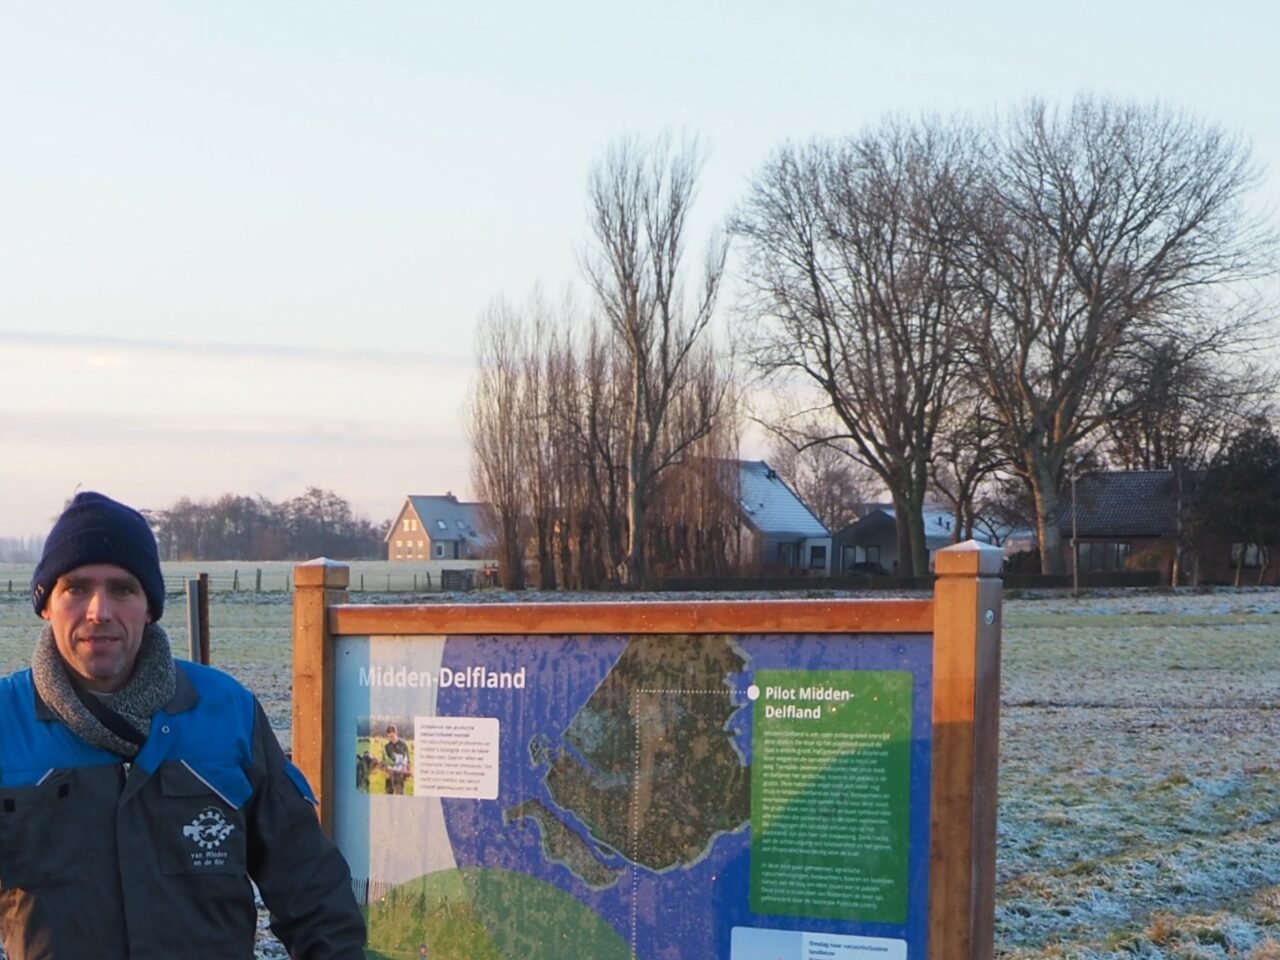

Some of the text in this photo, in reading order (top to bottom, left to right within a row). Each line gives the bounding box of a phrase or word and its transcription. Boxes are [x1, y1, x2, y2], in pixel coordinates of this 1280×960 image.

[359, 666, 526, 689] Midden-Delfland
[765, 686, 855, 701] Pilot Midden-
[765, 705, 821, 719] Delfland
